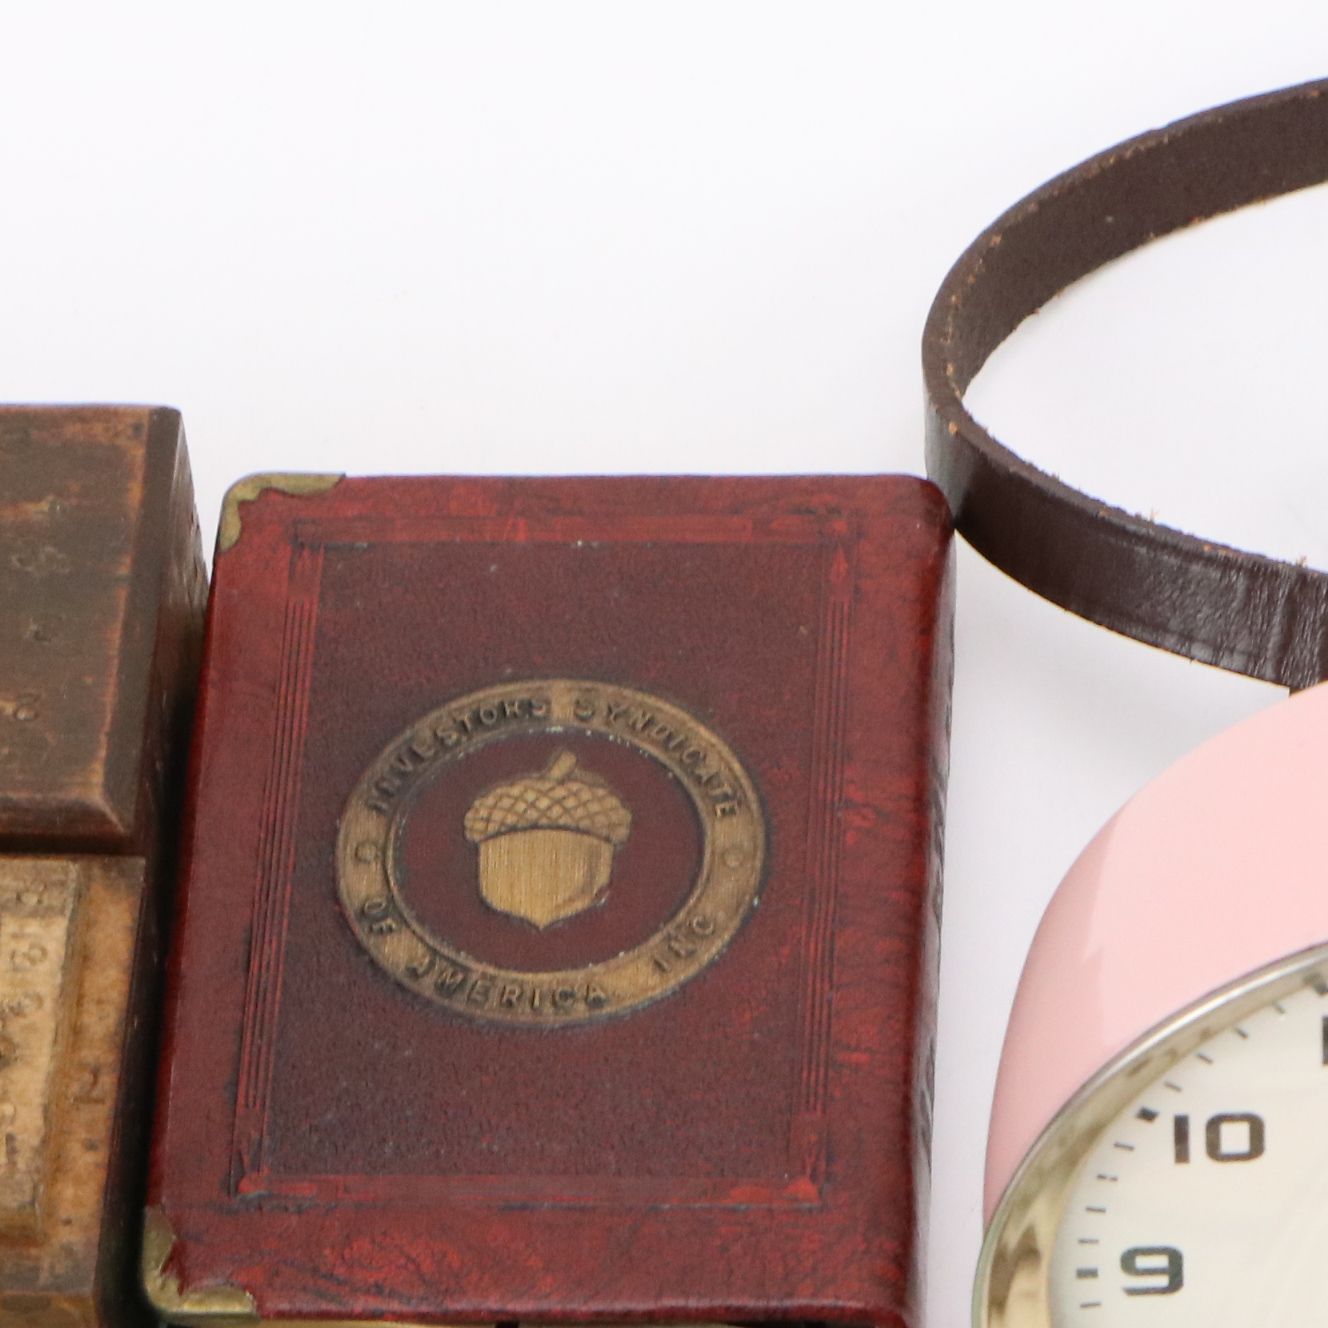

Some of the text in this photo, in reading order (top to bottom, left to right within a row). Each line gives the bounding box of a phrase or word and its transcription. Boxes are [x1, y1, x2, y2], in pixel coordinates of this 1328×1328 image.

[366, 697, 742, 820] INVESTORS SYNDICATE
[1173, 1112, 1265, 1165] 10
[1119, 1245, 1184, 1295] 9
